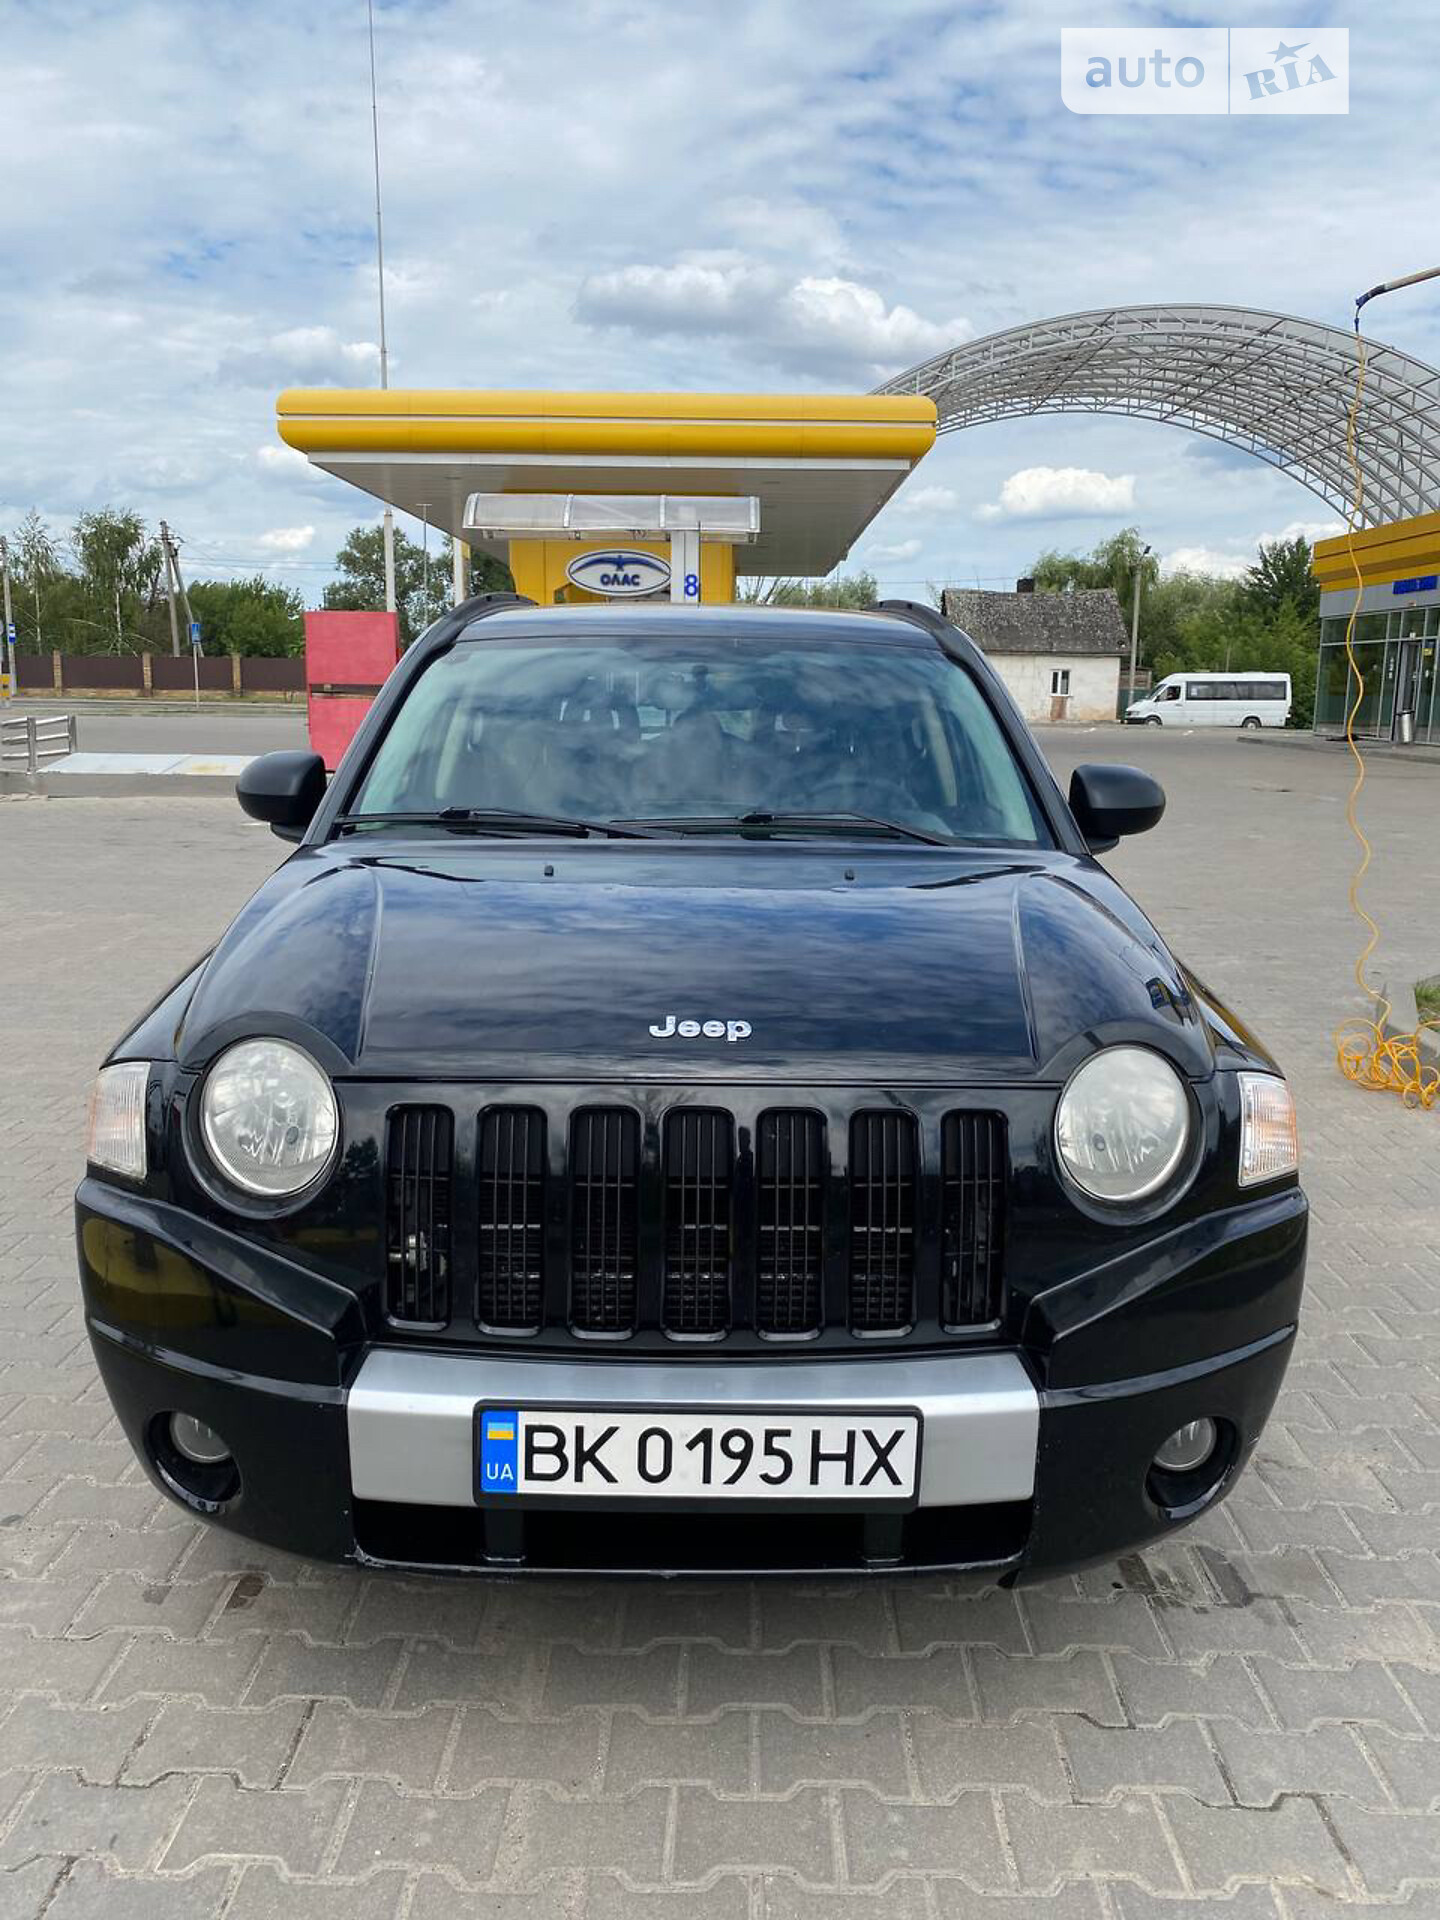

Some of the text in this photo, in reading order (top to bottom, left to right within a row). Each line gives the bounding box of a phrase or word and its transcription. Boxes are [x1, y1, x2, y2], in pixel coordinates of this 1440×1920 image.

[684, 574, 698, 597] 8
[649, 1015, 752, 1042] Jeep
[523, 1424, 905, 1486] BK 0195 HX
[486, 1463, 514, 1480] UA
